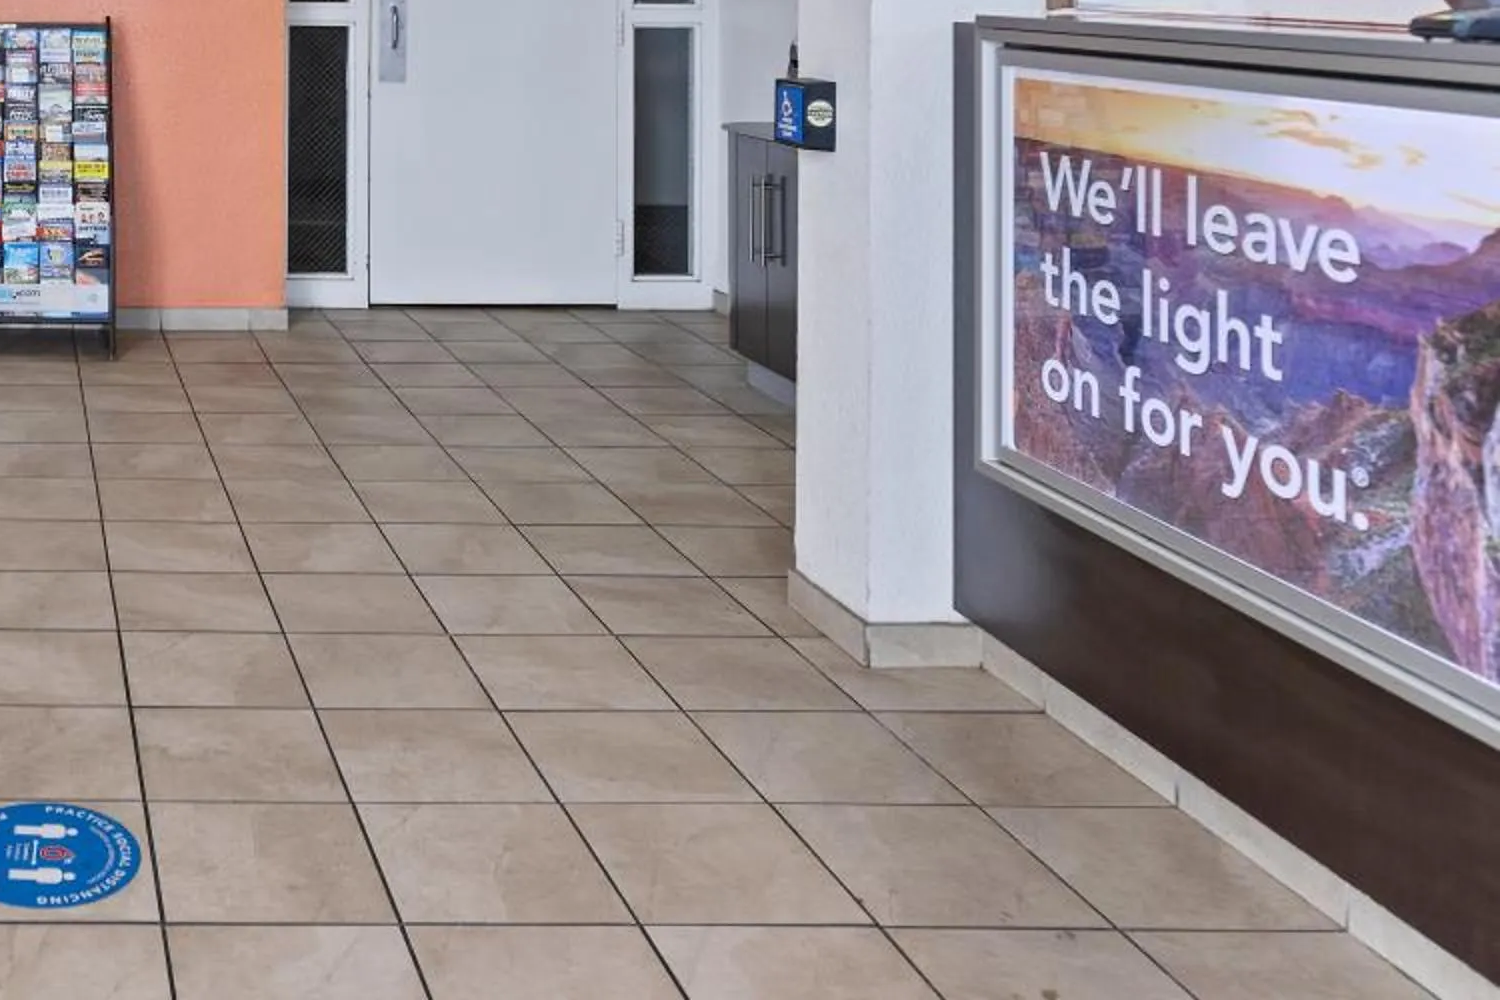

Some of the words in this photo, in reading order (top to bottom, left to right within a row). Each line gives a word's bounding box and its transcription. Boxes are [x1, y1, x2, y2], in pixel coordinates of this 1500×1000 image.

[1040, 151, 1161, 237] We'll
[1186, 174, 1361, 283] leave
[1040, 246, 1121, 325] the
[1142, 268, 1283, 382] light
[1041, 358, 1100, 419] on
[1119, 366, 1203, 457] for
[45, 805, 115, 833] PRACTICE
